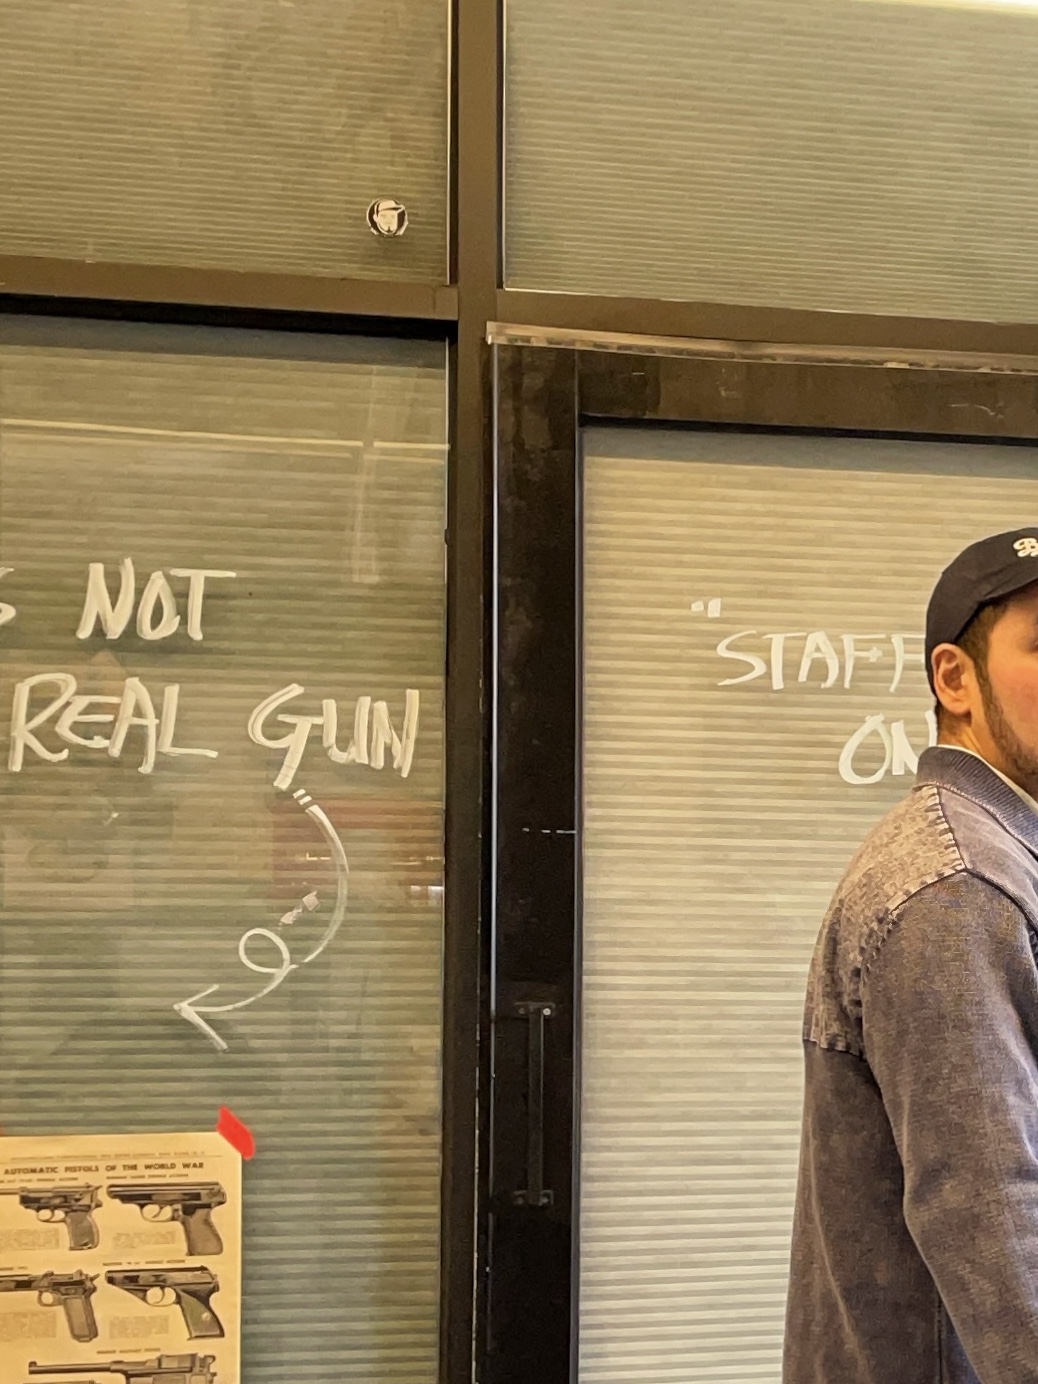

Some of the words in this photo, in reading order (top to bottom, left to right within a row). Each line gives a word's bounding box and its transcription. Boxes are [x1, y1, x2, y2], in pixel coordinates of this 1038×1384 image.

[76, 557, 237, 640] NOT
[8, 672, 218, 774] REAL
[248, 683, 419, 790] GUN
[838, 710, 937, 784] ON
[3, 1166, 58, 1176] AUTOMATIC
[64, 1164, 99, 1174] PISTOLS
[105, 1163, 117, 1172] OF
[122, 1163, 138, 1171] THE
[144, 1162, 176, 1171] WORLD
[182, 1161, 204, 1170] WAR
